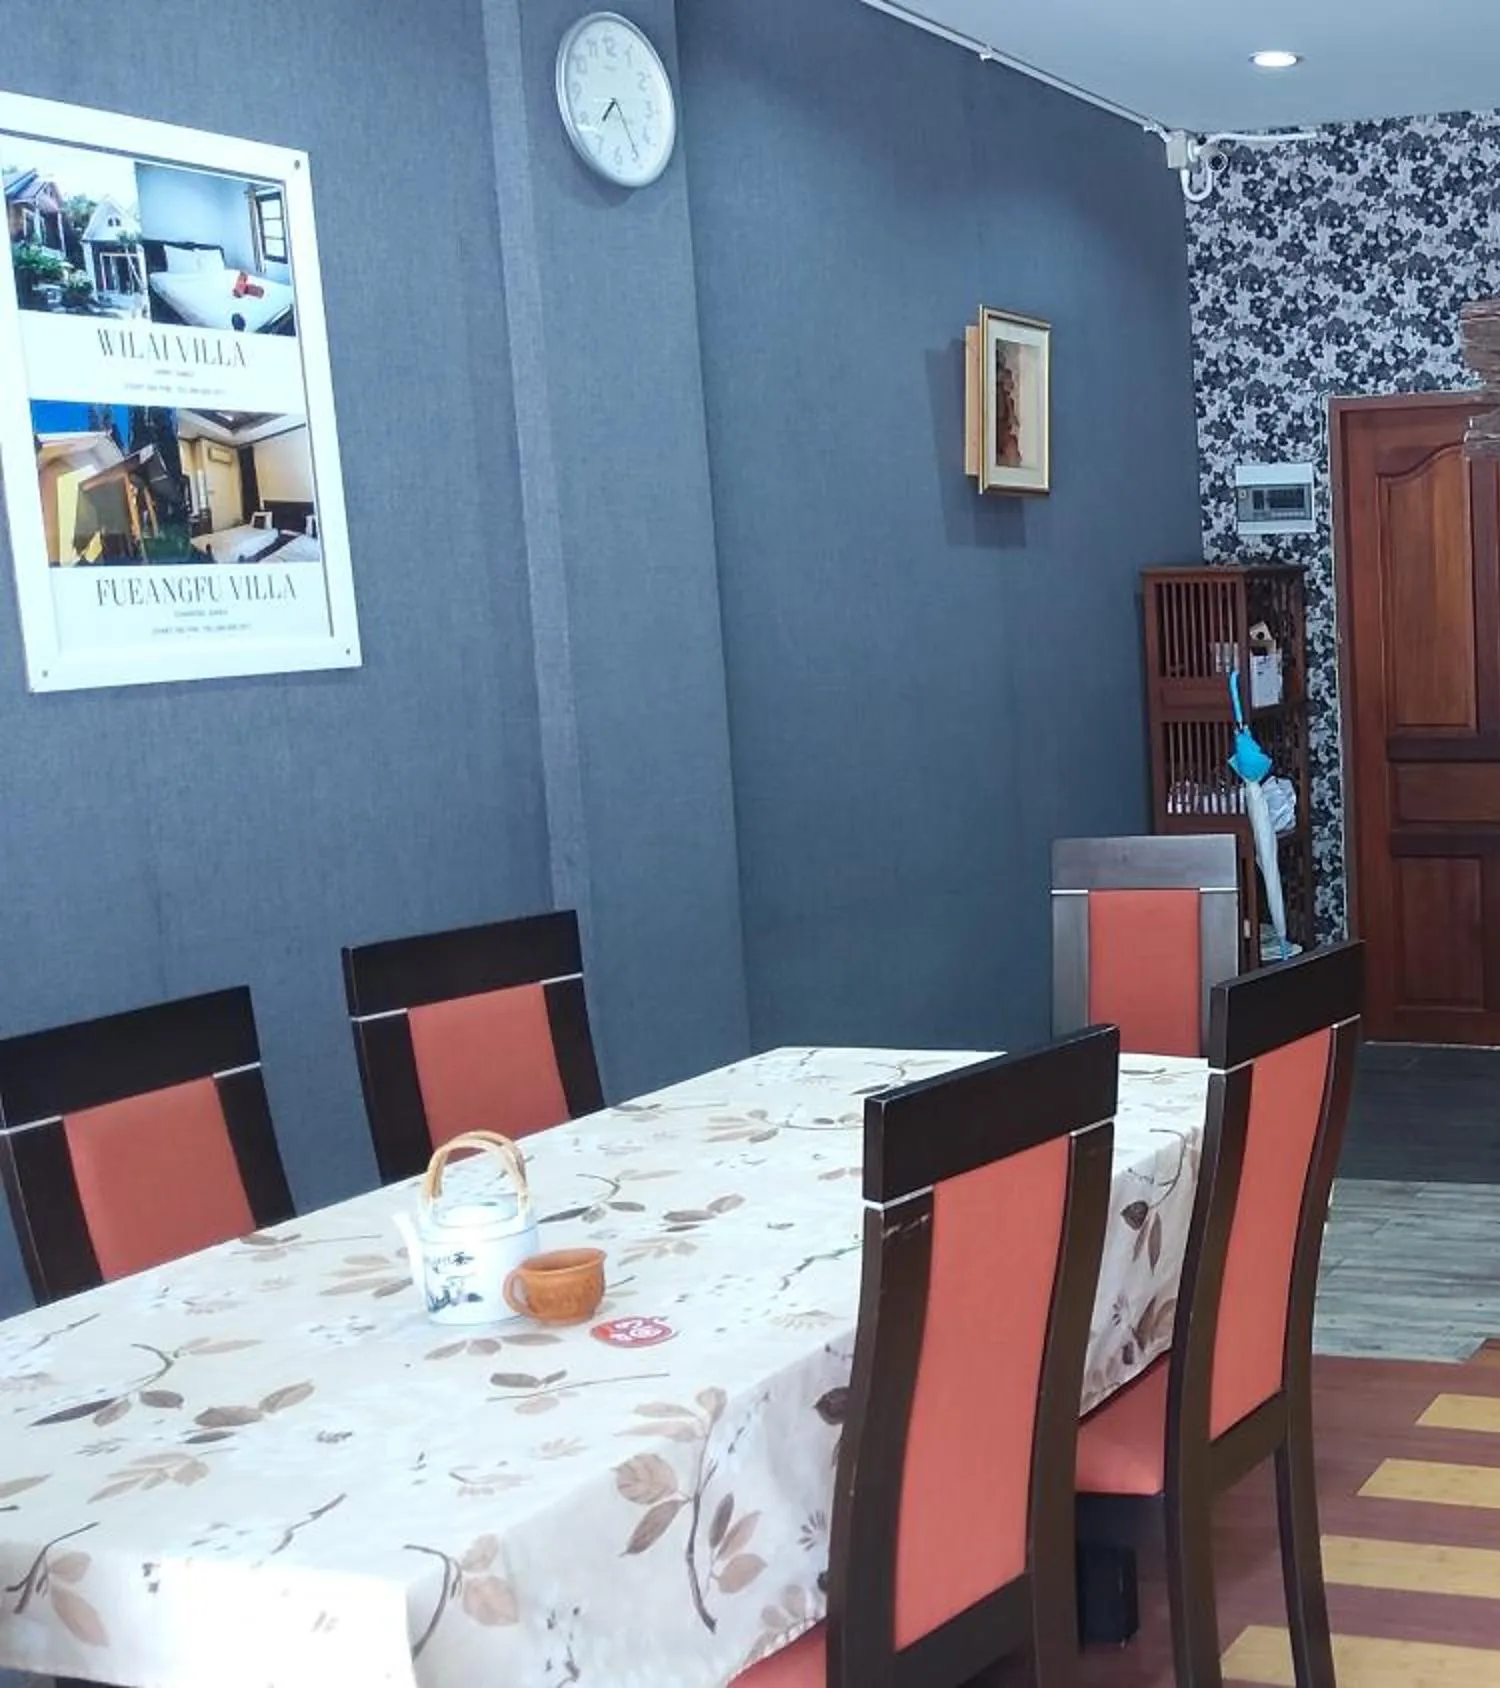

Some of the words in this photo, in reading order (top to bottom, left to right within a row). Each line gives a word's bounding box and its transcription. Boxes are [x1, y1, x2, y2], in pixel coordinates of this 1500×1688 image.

[636, 70, 648, 92] 2
[97, 328, 170, 361] WILAI
[176, 335, 247, 368] VILLA
[96, 575, 221, 607] FUEANGFU
[229, 573, 297, 601] VILLA
